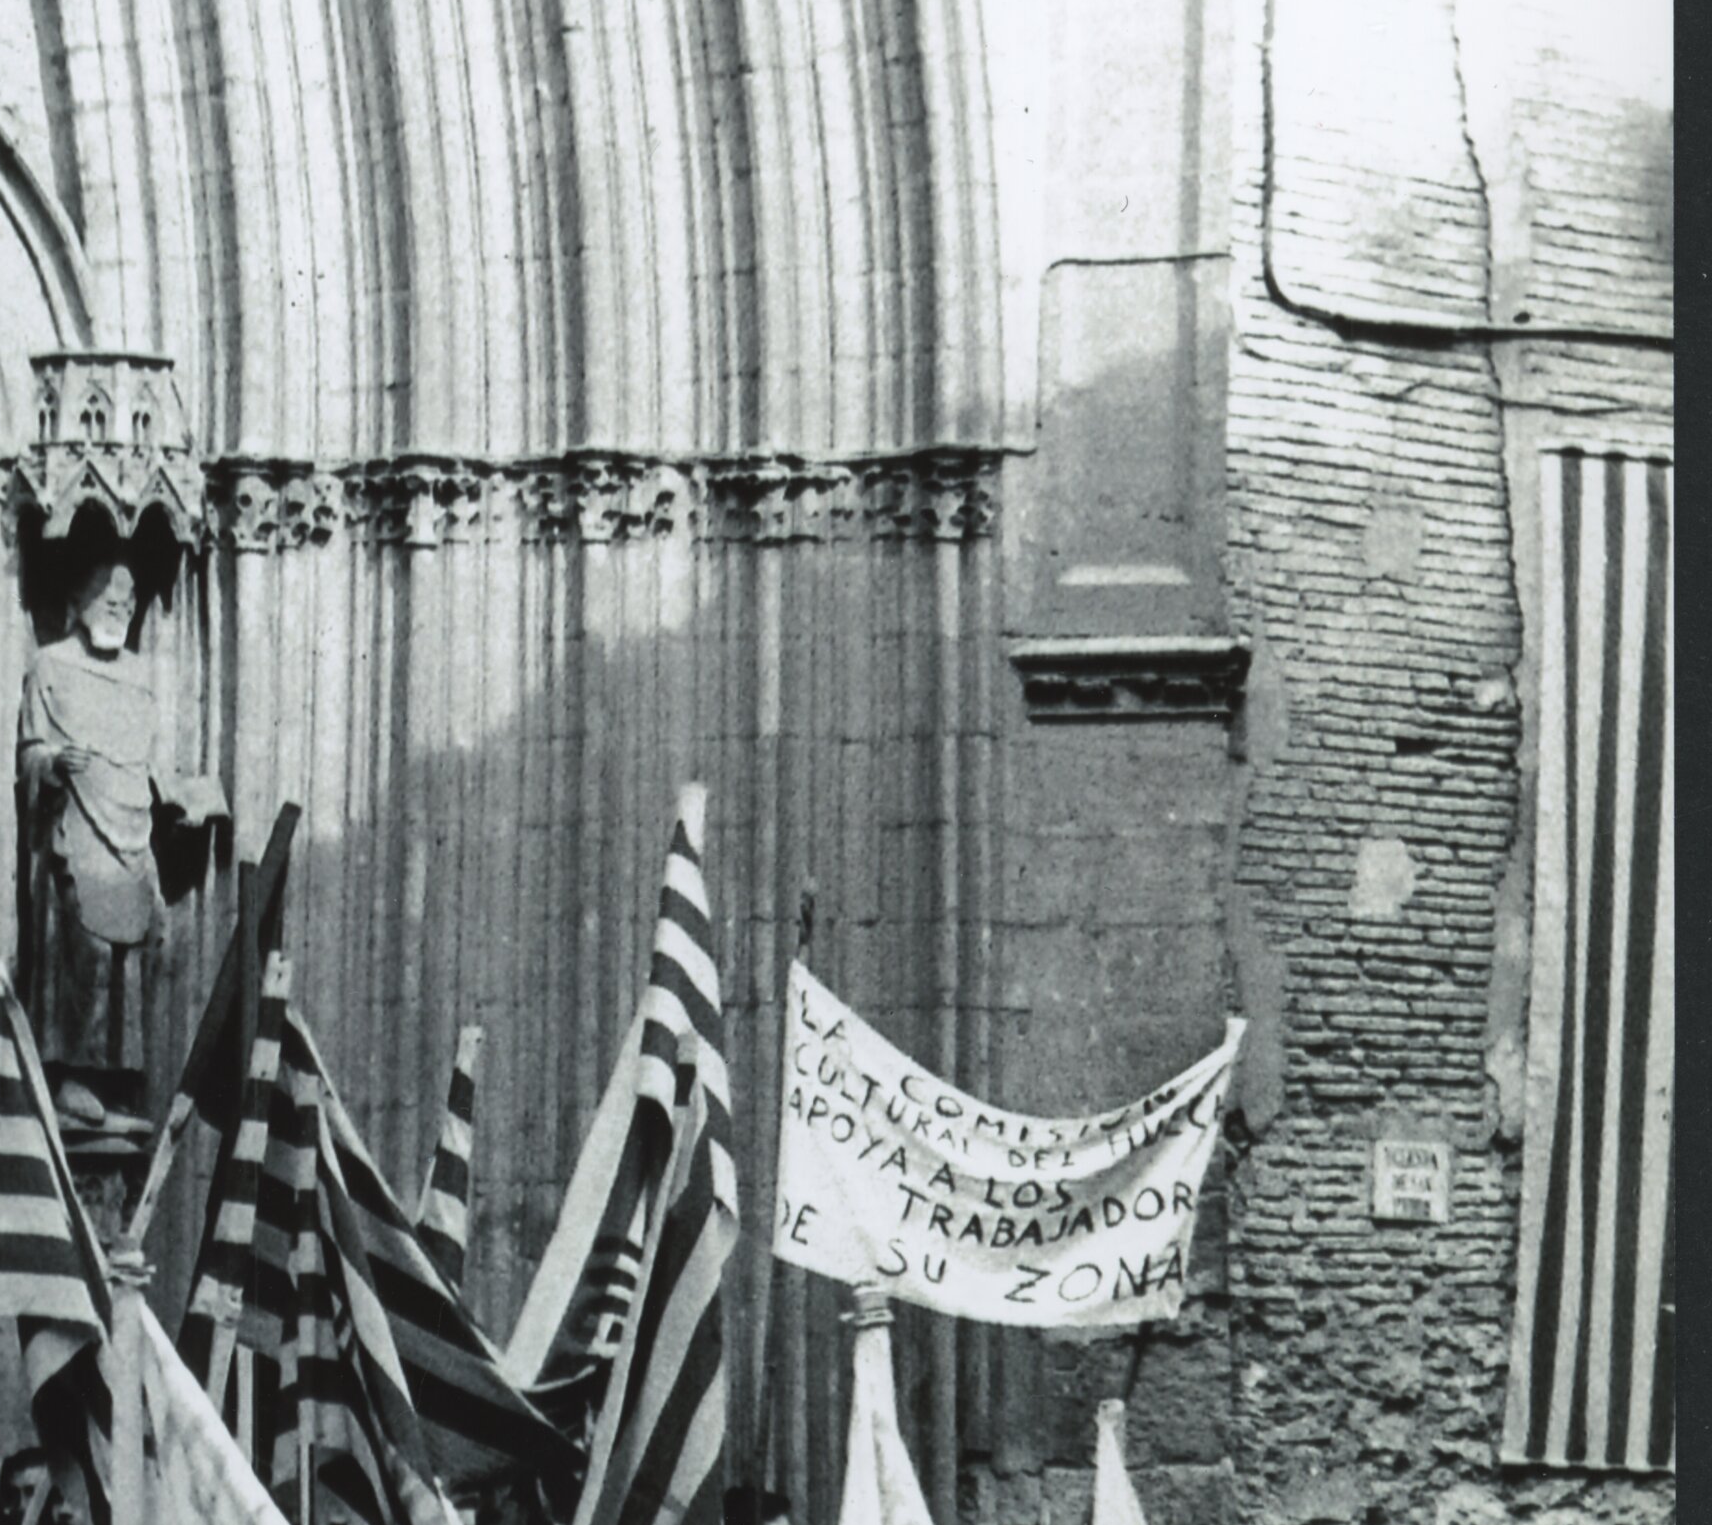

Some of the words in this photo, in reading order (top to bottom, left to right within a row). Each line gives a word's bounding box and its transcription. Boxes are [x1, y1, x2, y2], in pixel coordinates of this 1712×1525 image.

[800, 989, 845, 1041] LA
[788, 1086, 907, 1176] APOYA
[928, 1162, 956, 1193] A
[984, 1177, 1072, 1215] LOS
[1008, 1148, 1075, 1169] DEL
[876, 1238, 947, 1284] SU
[1004, 1242, 1184, 1303] ZONA
